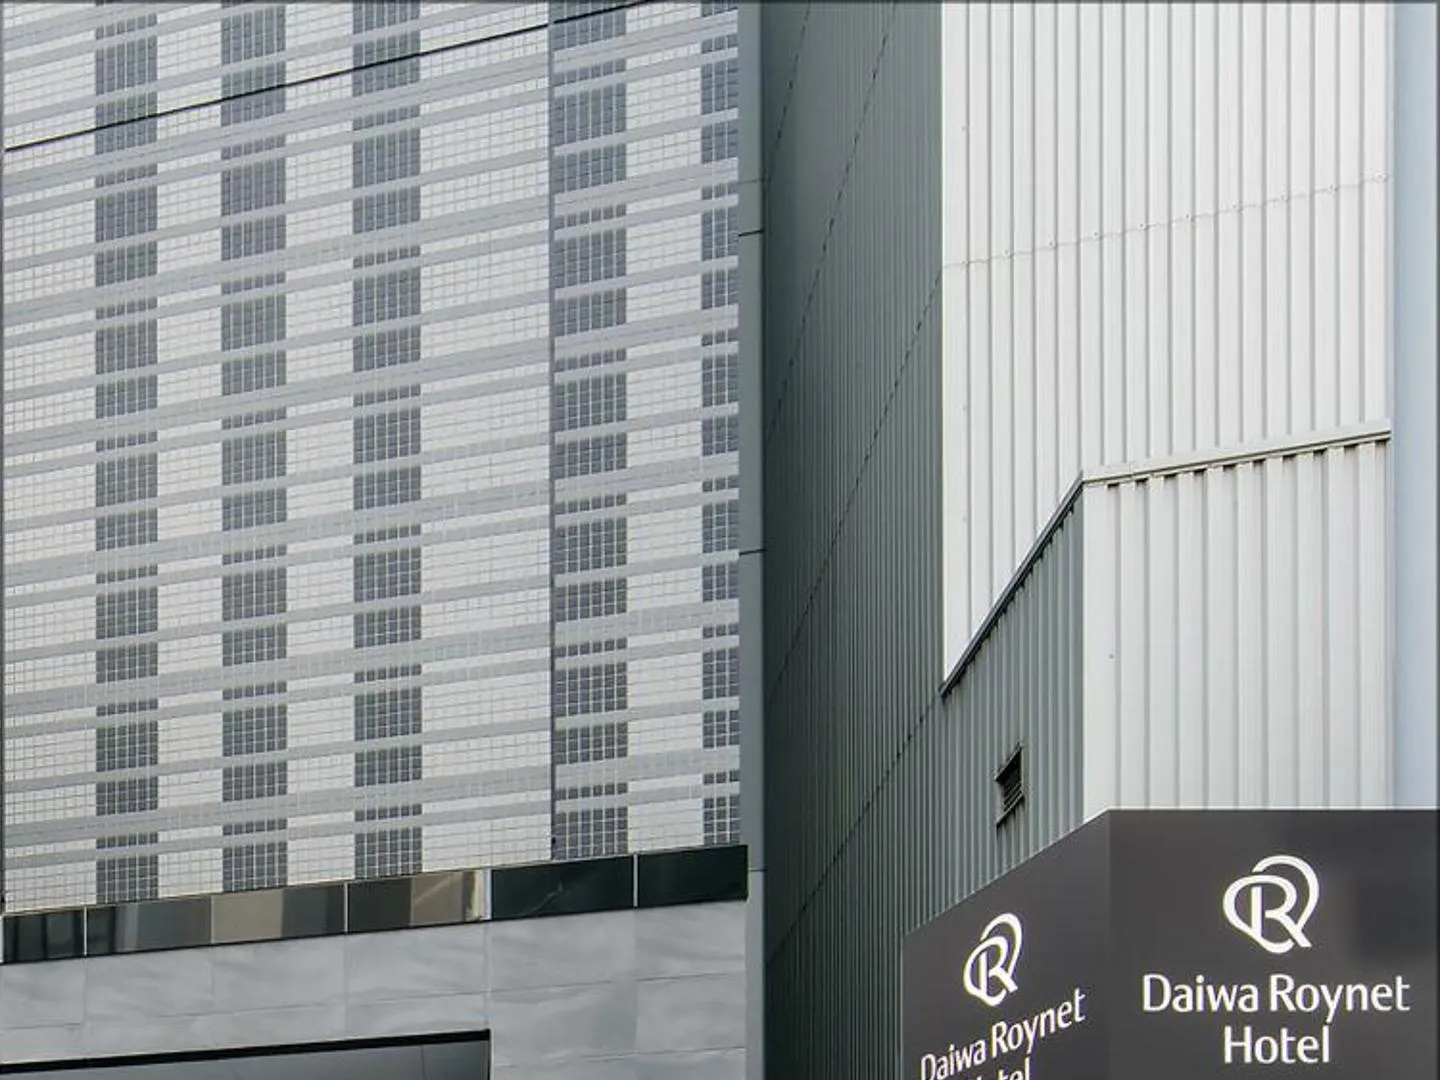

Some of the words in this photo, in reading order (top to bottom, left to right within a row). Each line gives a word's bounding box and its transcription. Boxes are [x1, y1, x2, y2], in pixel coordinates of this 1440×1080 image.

[991, 987, 1086, 1059] Roynet
[1143, 973, 1259, 1013] Daiwa
[1270, 973, 1411, 1023] Roynet
[1224, 1025, 1330, 1064] Hotel
